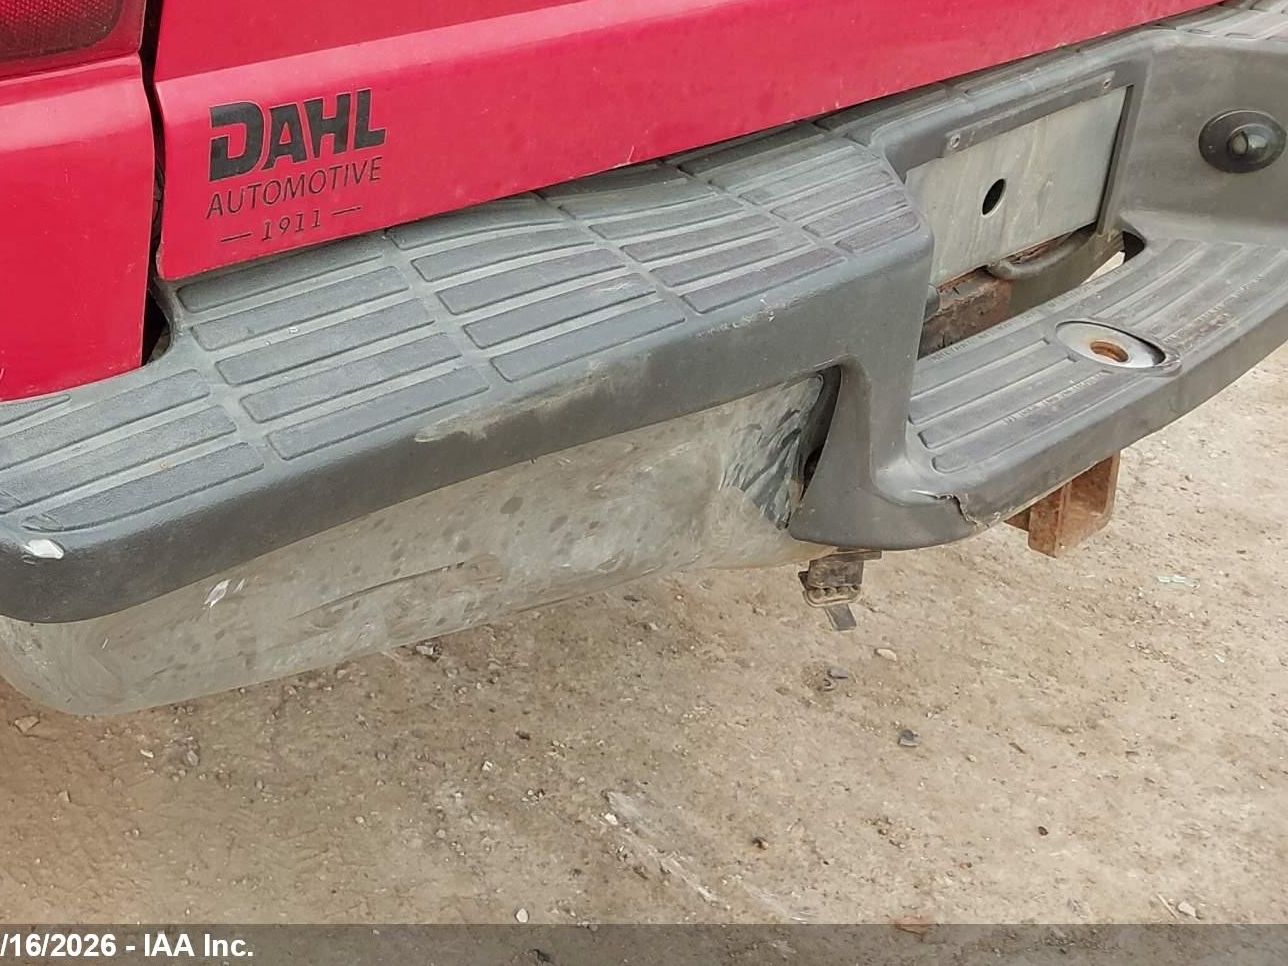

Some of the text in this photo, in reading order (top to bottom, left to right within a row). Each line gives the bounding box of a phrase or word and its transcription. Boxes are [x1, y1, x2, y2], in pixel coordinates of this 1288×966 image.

[208, 88, 387, 183] DAHL
[205, 156, 383, 220] AUTOMOTIVE
[261, 208, 322, 243] 1911
